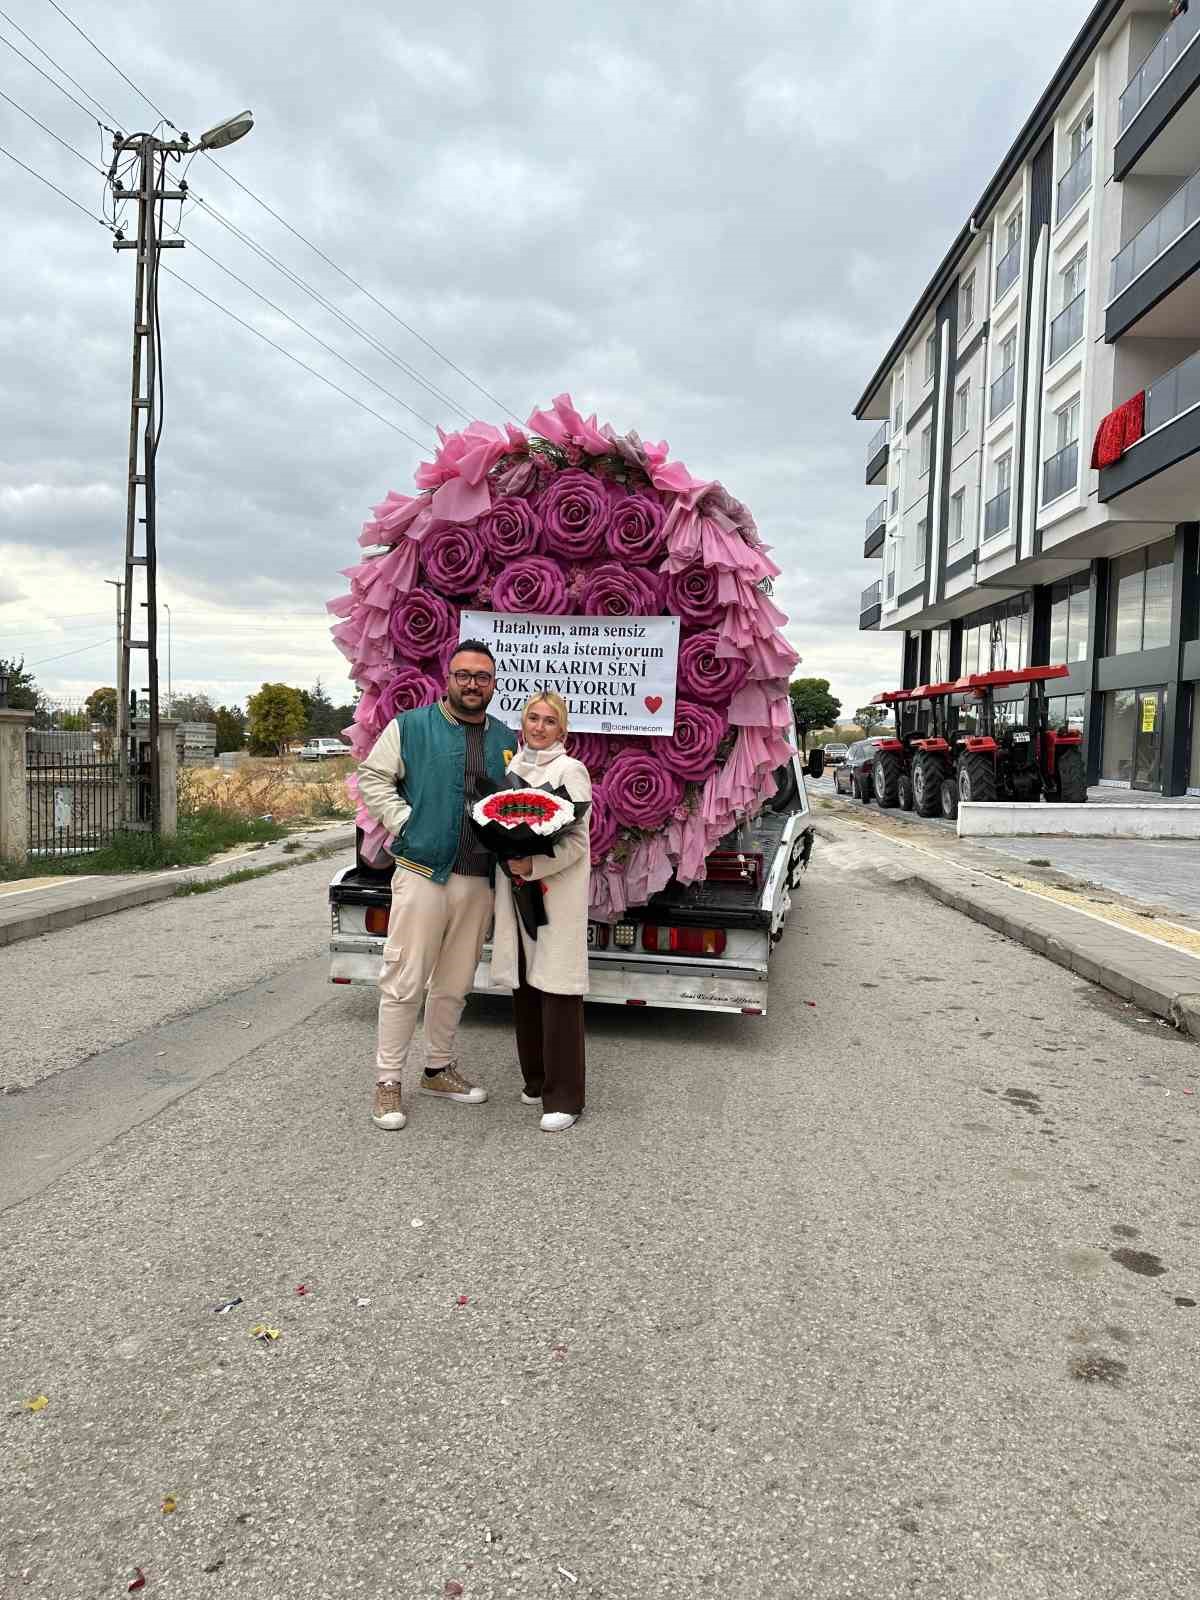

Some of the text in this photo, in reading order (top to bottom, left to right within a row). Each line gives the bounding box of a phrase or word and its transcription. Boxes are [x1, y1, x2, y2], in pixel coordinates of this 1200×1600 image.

[493, 620, 647, 639] Hatalıyım, ama sensiz
[496, 639, 539, 656] hayatı
[543, 641, 569, 655] asla
[574, 641, 664, 660] istemiyorum
[494, 658, 647, 677] ANIM KARIM SENİ
[495, 676, 636, 697] ÇOK SEVİYORUM
[500, 694, 531, 712] ÖZ
